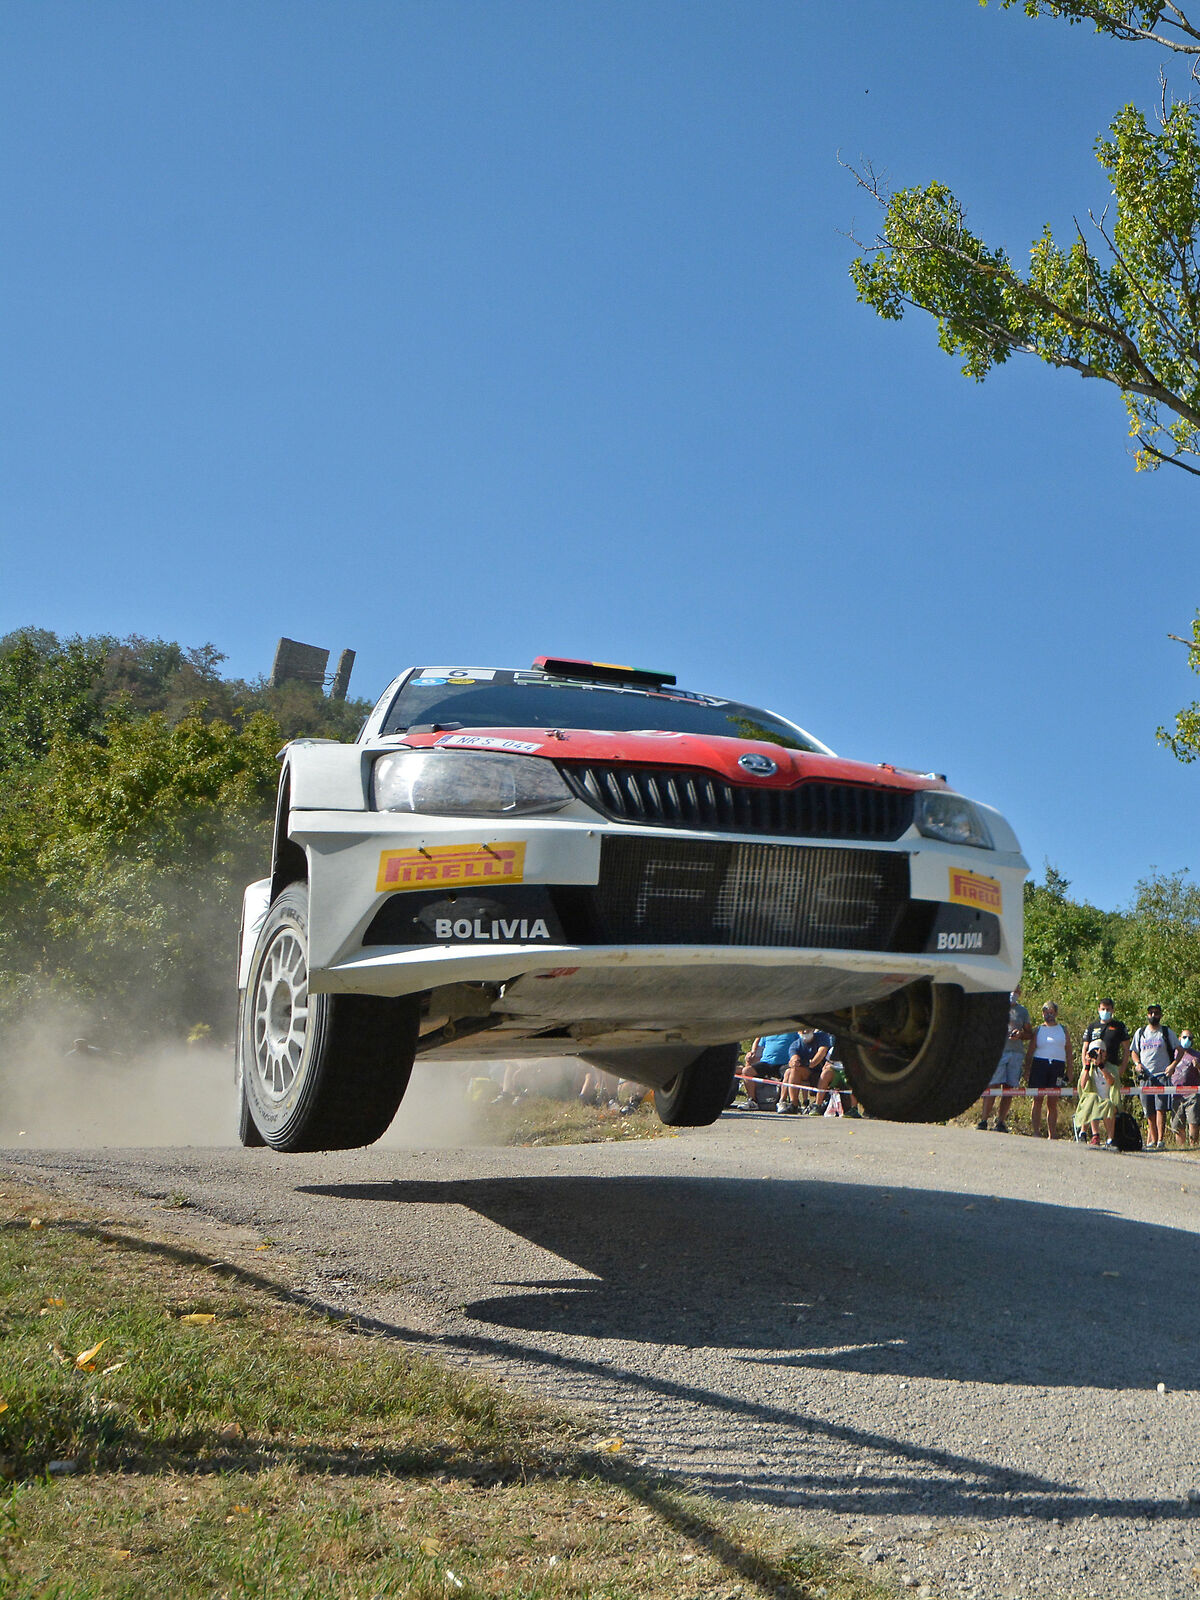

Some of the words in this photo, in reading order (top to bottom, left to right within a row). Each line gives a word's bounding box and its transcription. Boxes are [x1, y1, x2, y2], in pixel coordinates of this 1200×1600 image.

[448, 669, 468, 677] 6
[385, 849, 516, 883] PIRELLI
[953, 873, 1000, 907] PIRELLI
[435, 918, 550, 940] BOLIVIA
[937, 932, 982, 950] BOLIVIA
